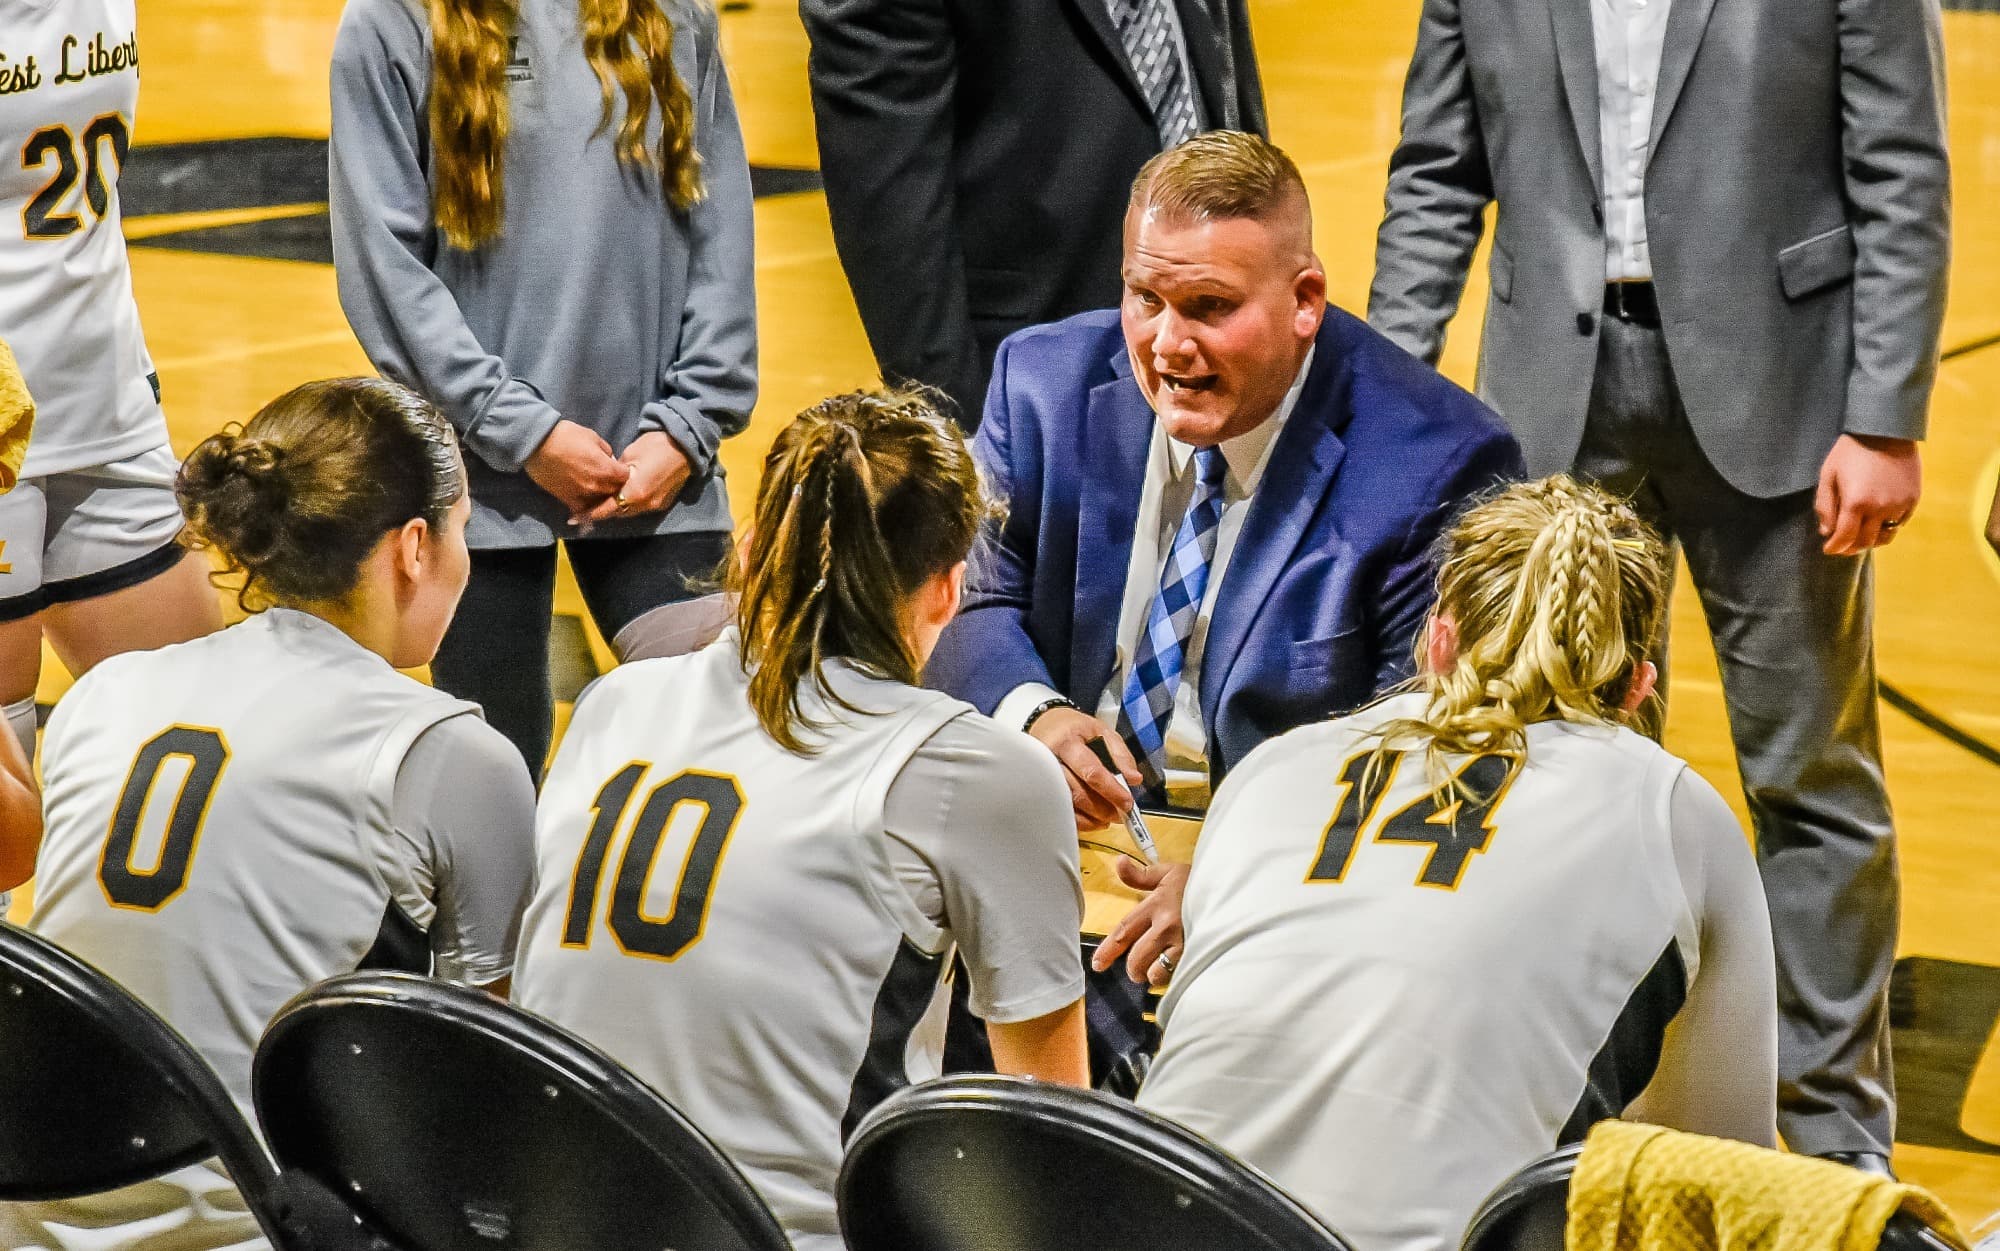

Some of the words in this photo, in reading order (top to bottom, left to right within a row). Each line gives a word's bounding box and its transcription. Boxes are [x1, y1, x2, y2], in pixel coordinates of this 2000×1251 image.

[0, 53, 41, 94] est
[55, 31, 139, 84] Libert
[21, 111, 131, 240] 20
[96, 722, 232, 915] 0
[560, 759, 748, 964] 10
[1303, 749, 1521, 892] 14
